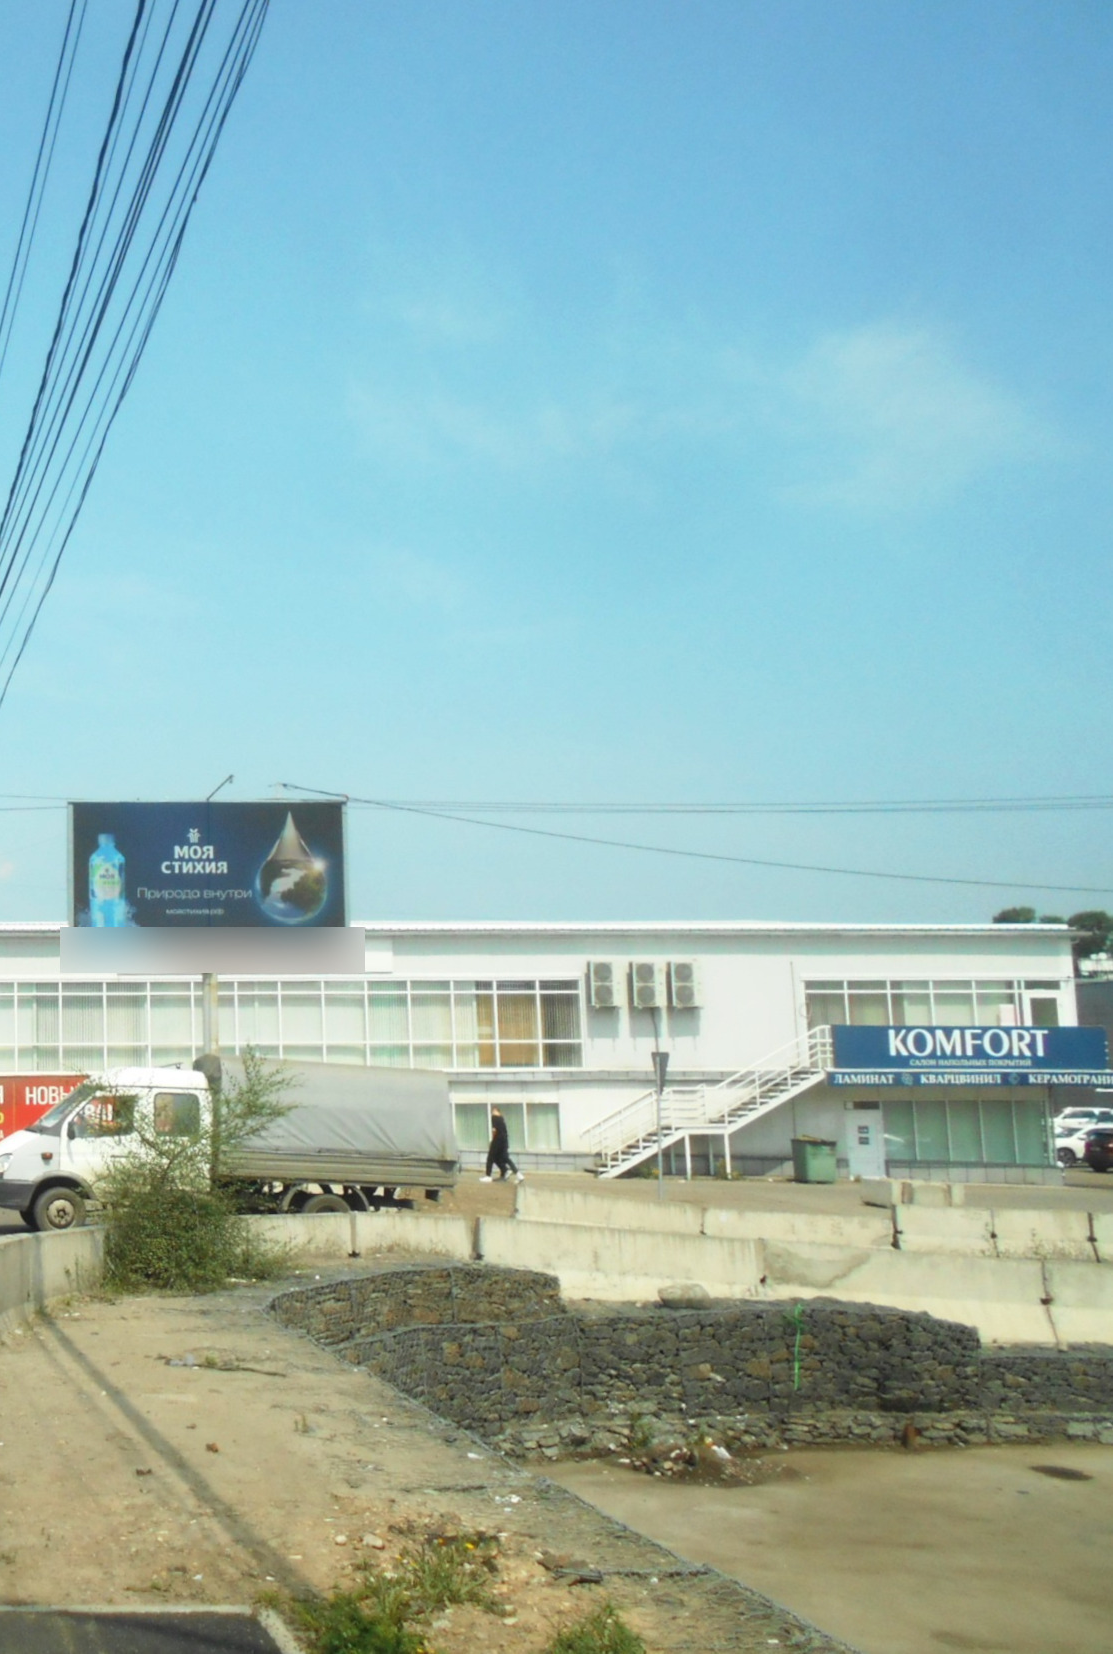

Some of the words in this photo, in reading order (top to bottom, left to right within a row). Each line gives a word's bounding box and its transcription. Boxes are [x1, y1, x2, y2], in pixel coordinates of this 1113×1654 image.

[173, 845, 214, 860] МОЯ
[161, 861, 228, 875] СТИХИЯ
[137, 887, 201, 900] Природа
[204, 889, 253, 900] внутри
[888, 1028, 1049, 1057] KOMFORT
[834, 1073, 895, 1084] ЛАМИНАТ
[920, 1073, 1002, 1085] КВАРЦВИНИЛ
